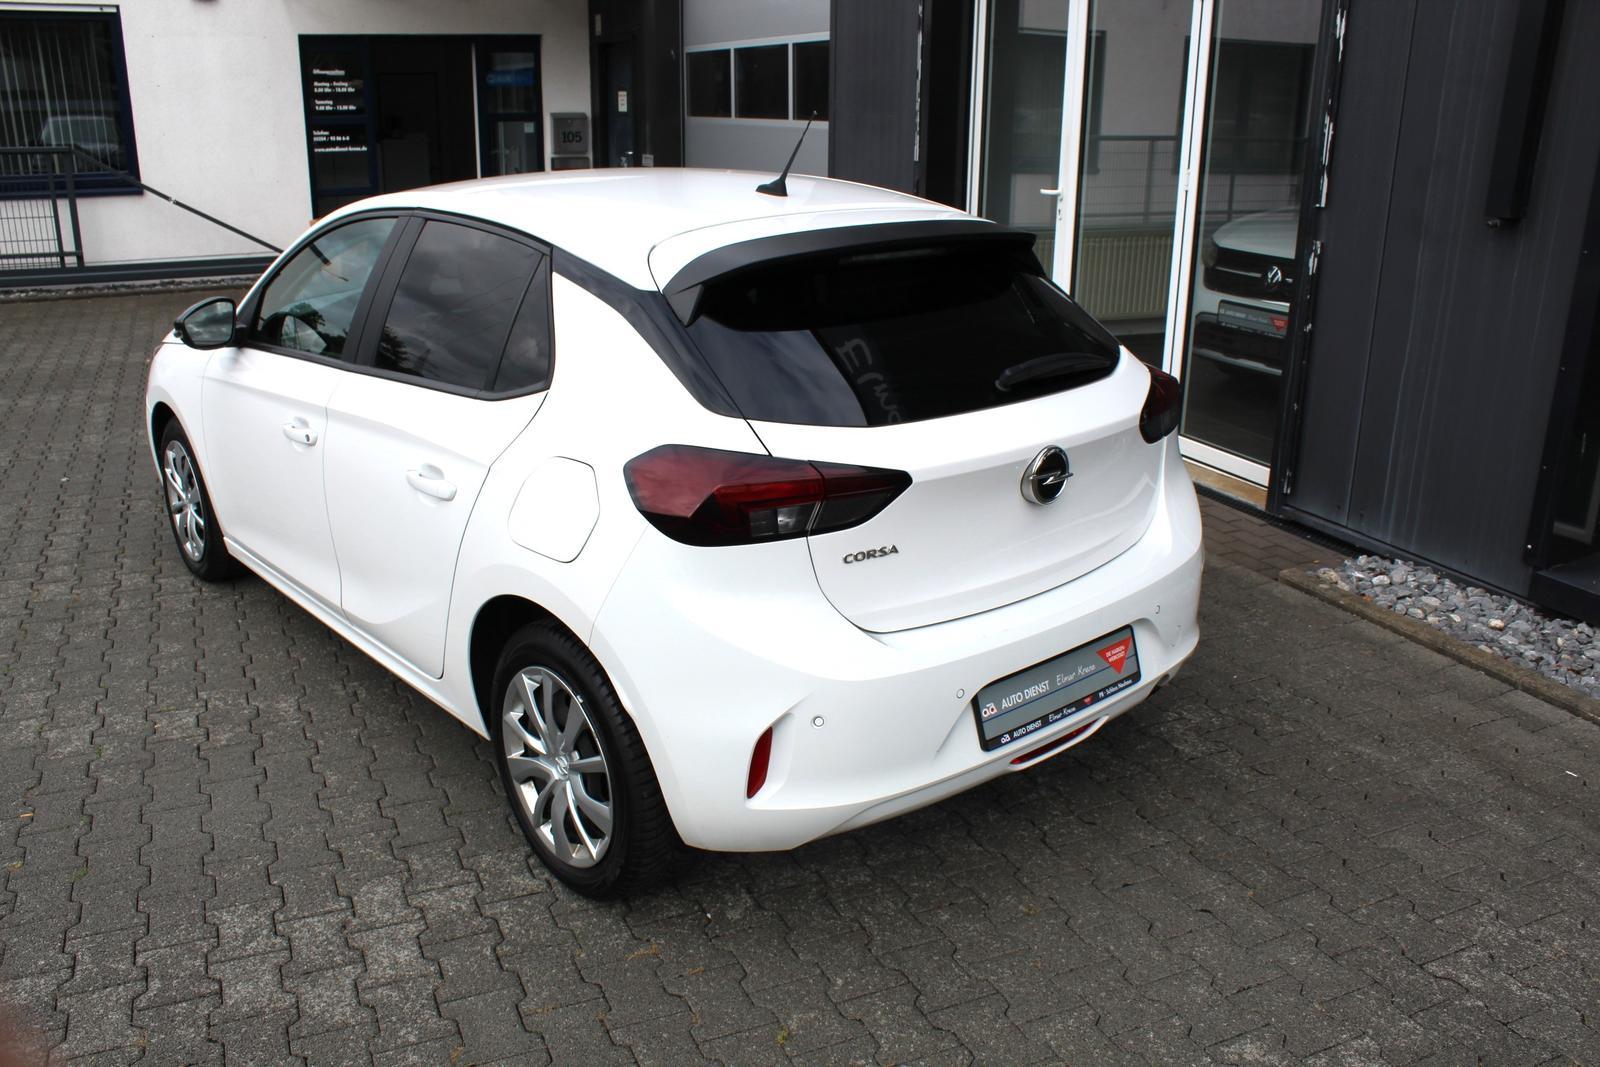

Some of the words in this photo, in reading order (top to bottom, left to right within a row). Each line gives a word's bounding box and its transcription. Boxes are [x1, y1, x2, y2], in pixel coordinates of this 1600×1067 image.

[562, 131, 582, 143] 105
[843, 544, 899, 564] CORSA
[1001, 692, 1023, 710] AUTO
[1024, 680, 1051, 700] DIENST
[1013, 727, 1026, 738] AUTO
[1027, 720, 1042, 732] DIENST
